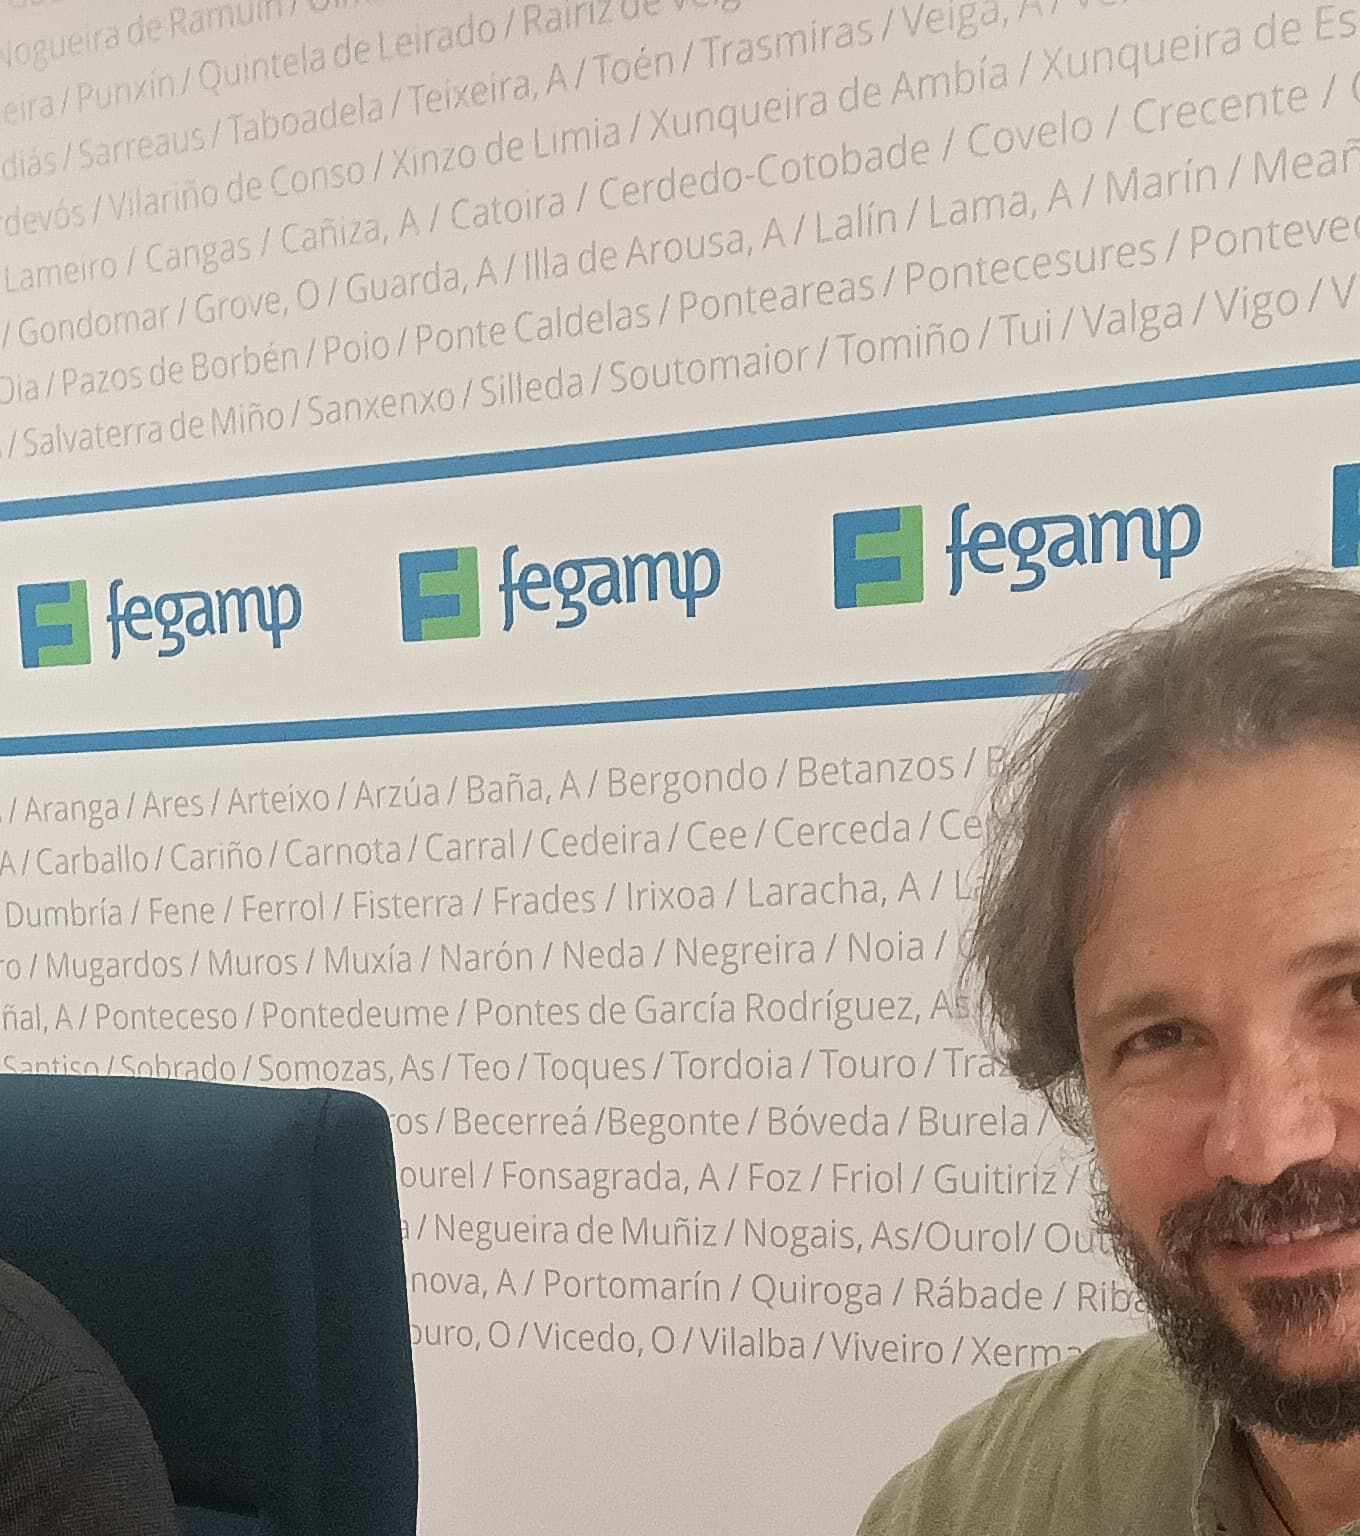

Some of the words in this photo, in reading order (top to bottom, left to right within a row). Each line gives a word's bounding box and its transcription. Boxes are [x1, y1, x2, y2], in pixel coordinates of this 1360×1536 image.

[4, 256, 117, 293] Lameiro
[146, 236, 251, 275] Cangas
[281, 217, 388, 254] Cañiza,
[399, 205, 419, 238] A
[451, 191, 564, 230] Catoira
[599, 135, 929, 209] Cerdedo-Cotobade
[968, 110, 1092, 157] Covelo
[1134, 85, 1308, 134] Crecente
[62, 365, 142, 396] Pazos
[149, 354, 183, 387] de
[191, 341, 298, 382] Borbén
[324, 334, 389, 365] Poio
[416, 320, 506, 354] Ponte
[515, 298, 650, 343] Caldelas
[680, 274, 874, 322] Ponteareas
[906, 238, 1156, 293] Pontecesures
[23, 420, 162, 458] Salvaterra
[170, 410, 204, 442] de
[212, 401, 284, 436] Miño
[308, 387, 455, 426] Sanxenxo
[481, 367, 582, 408] Silleda
[610, 343, 809, 394] Soutomaior
[836, 321, 969, 365] Tomiño
[999, 308, 1050, 346] Tui
[1082, 298, 1182, 342] Valga
[1214, 285, 1298, 330] Vigo
[501, 546, 722, 632] fegamp
[946, 504, 1203, 597] fegamp
[108, 581, 303, 659] fegamp
[25, 796, 118, 830] Aranga
[143, 790, 204, 819] Ares
[228, 783, 329, 815] Arteixo
[354, 775, 439, 809] Arzúa
[467, 771, 551, 805] Baña,
[560, 769, 580, 800] A
[608, 758, 767, 804] Bergondo
[799, 754, 954, 788] Betanzos
[6, 896, 122, 929] Dumbría
[150, 896, 214, 925] Fene
[243, 890, 324, 923] Ferrol
[354, 890, 463, 919] Fisterra
[494, 883, 595, 915] Frades
[628, 880, 714, 911] Irixoa
[749, 872, 886, 908] Laracha,
[898, 870, 920, 902] A
[503, 1159, 689, 1199] Fonsagrada,
[699, 1161, 720, 1192] A
[749, 1161, 801, 1193] Foz
[833, 1160, 902, 1194] Friol
[934, 1162, 1056, 1195] Guitiriz
[545, 1268, 720, 1301] Portomarín
[752, 1272, 881, 1315] Quiroga
[916, 1276, 1042, 1311] Rábade
[534, 1321, 643, 1357] Vicedo,
[652, 1324, 675, 1355] O
[700, 1326, 804, 1359] Vilalba
[831, 1330, 943, 1364] Viveiro
